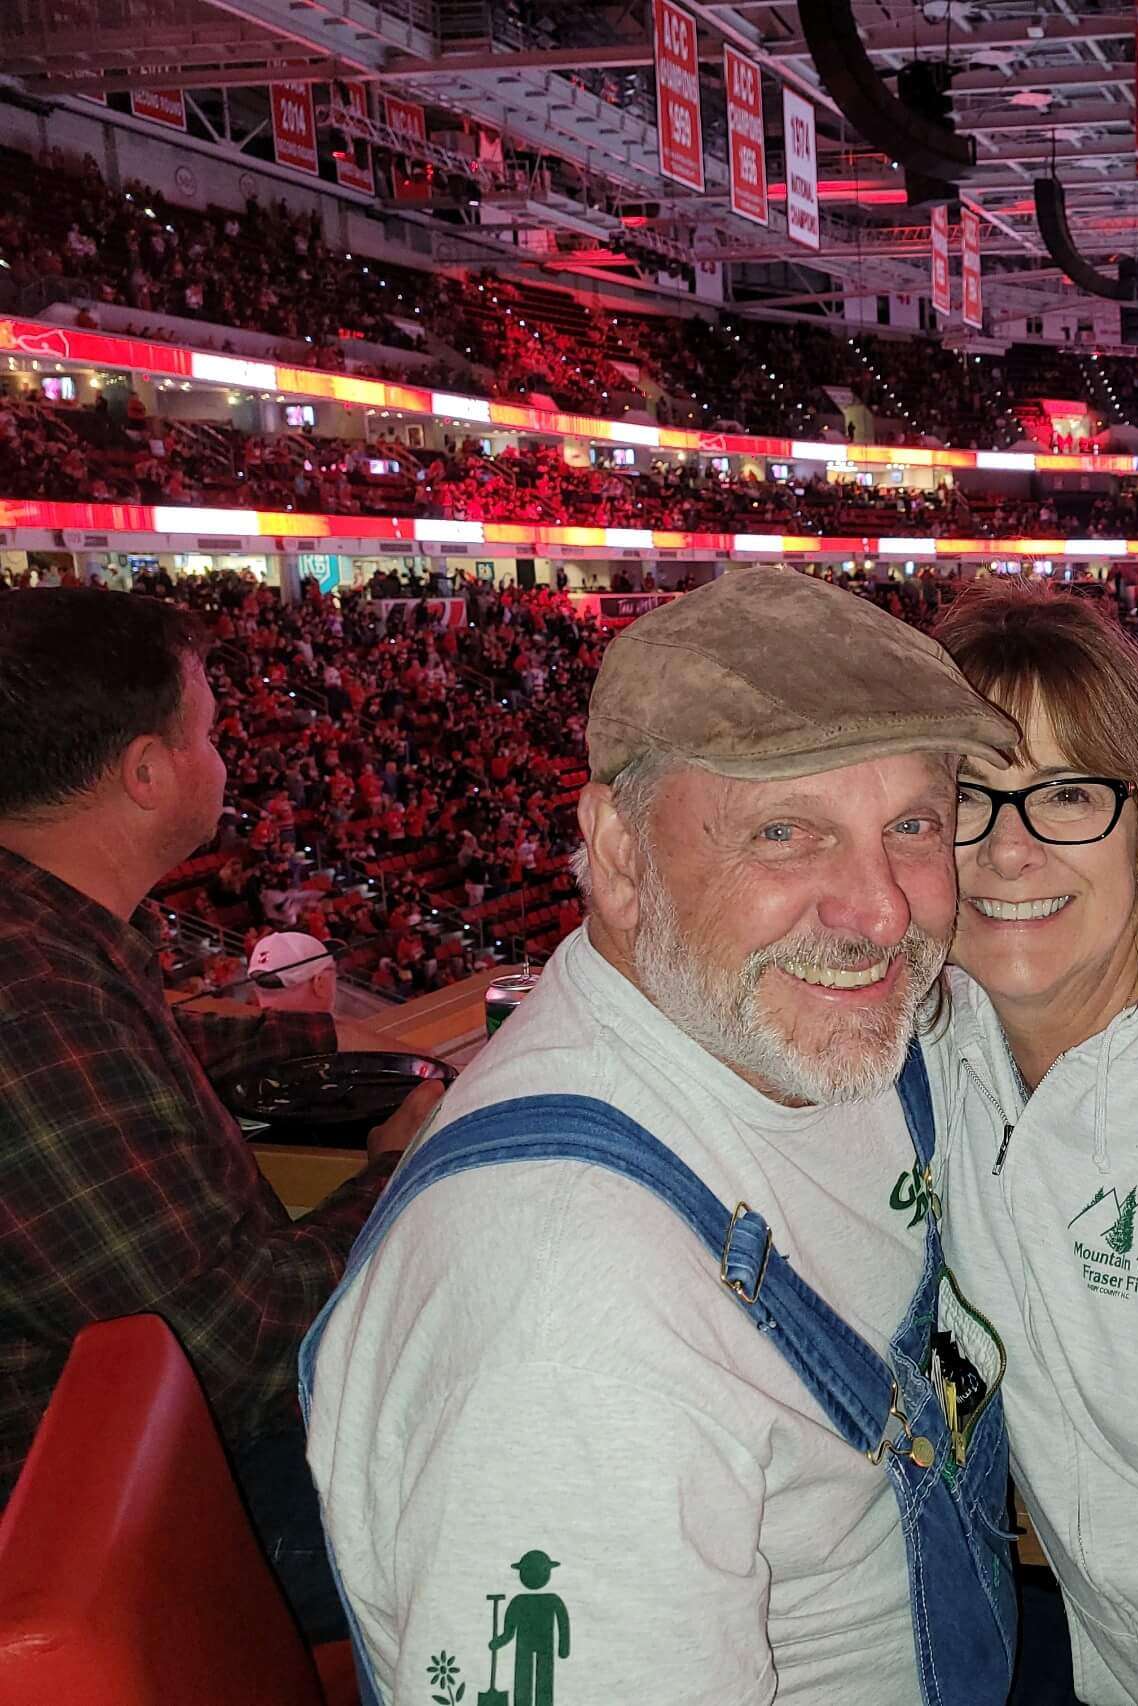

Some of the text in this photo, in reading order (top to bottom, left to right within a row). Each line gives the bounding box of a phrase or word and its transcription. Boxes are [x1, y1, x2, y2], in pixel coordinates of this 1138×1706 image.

[664, 10, 688, 61] ACC
[733, 60, 754, 105] ACC
[281, 98, 306, 136] 2014
[790, 115, 810, 162] 1974
[1073, 1240, 1131, 1272] Mountain
[1082, 1263, 1124, 1289] Fraser
